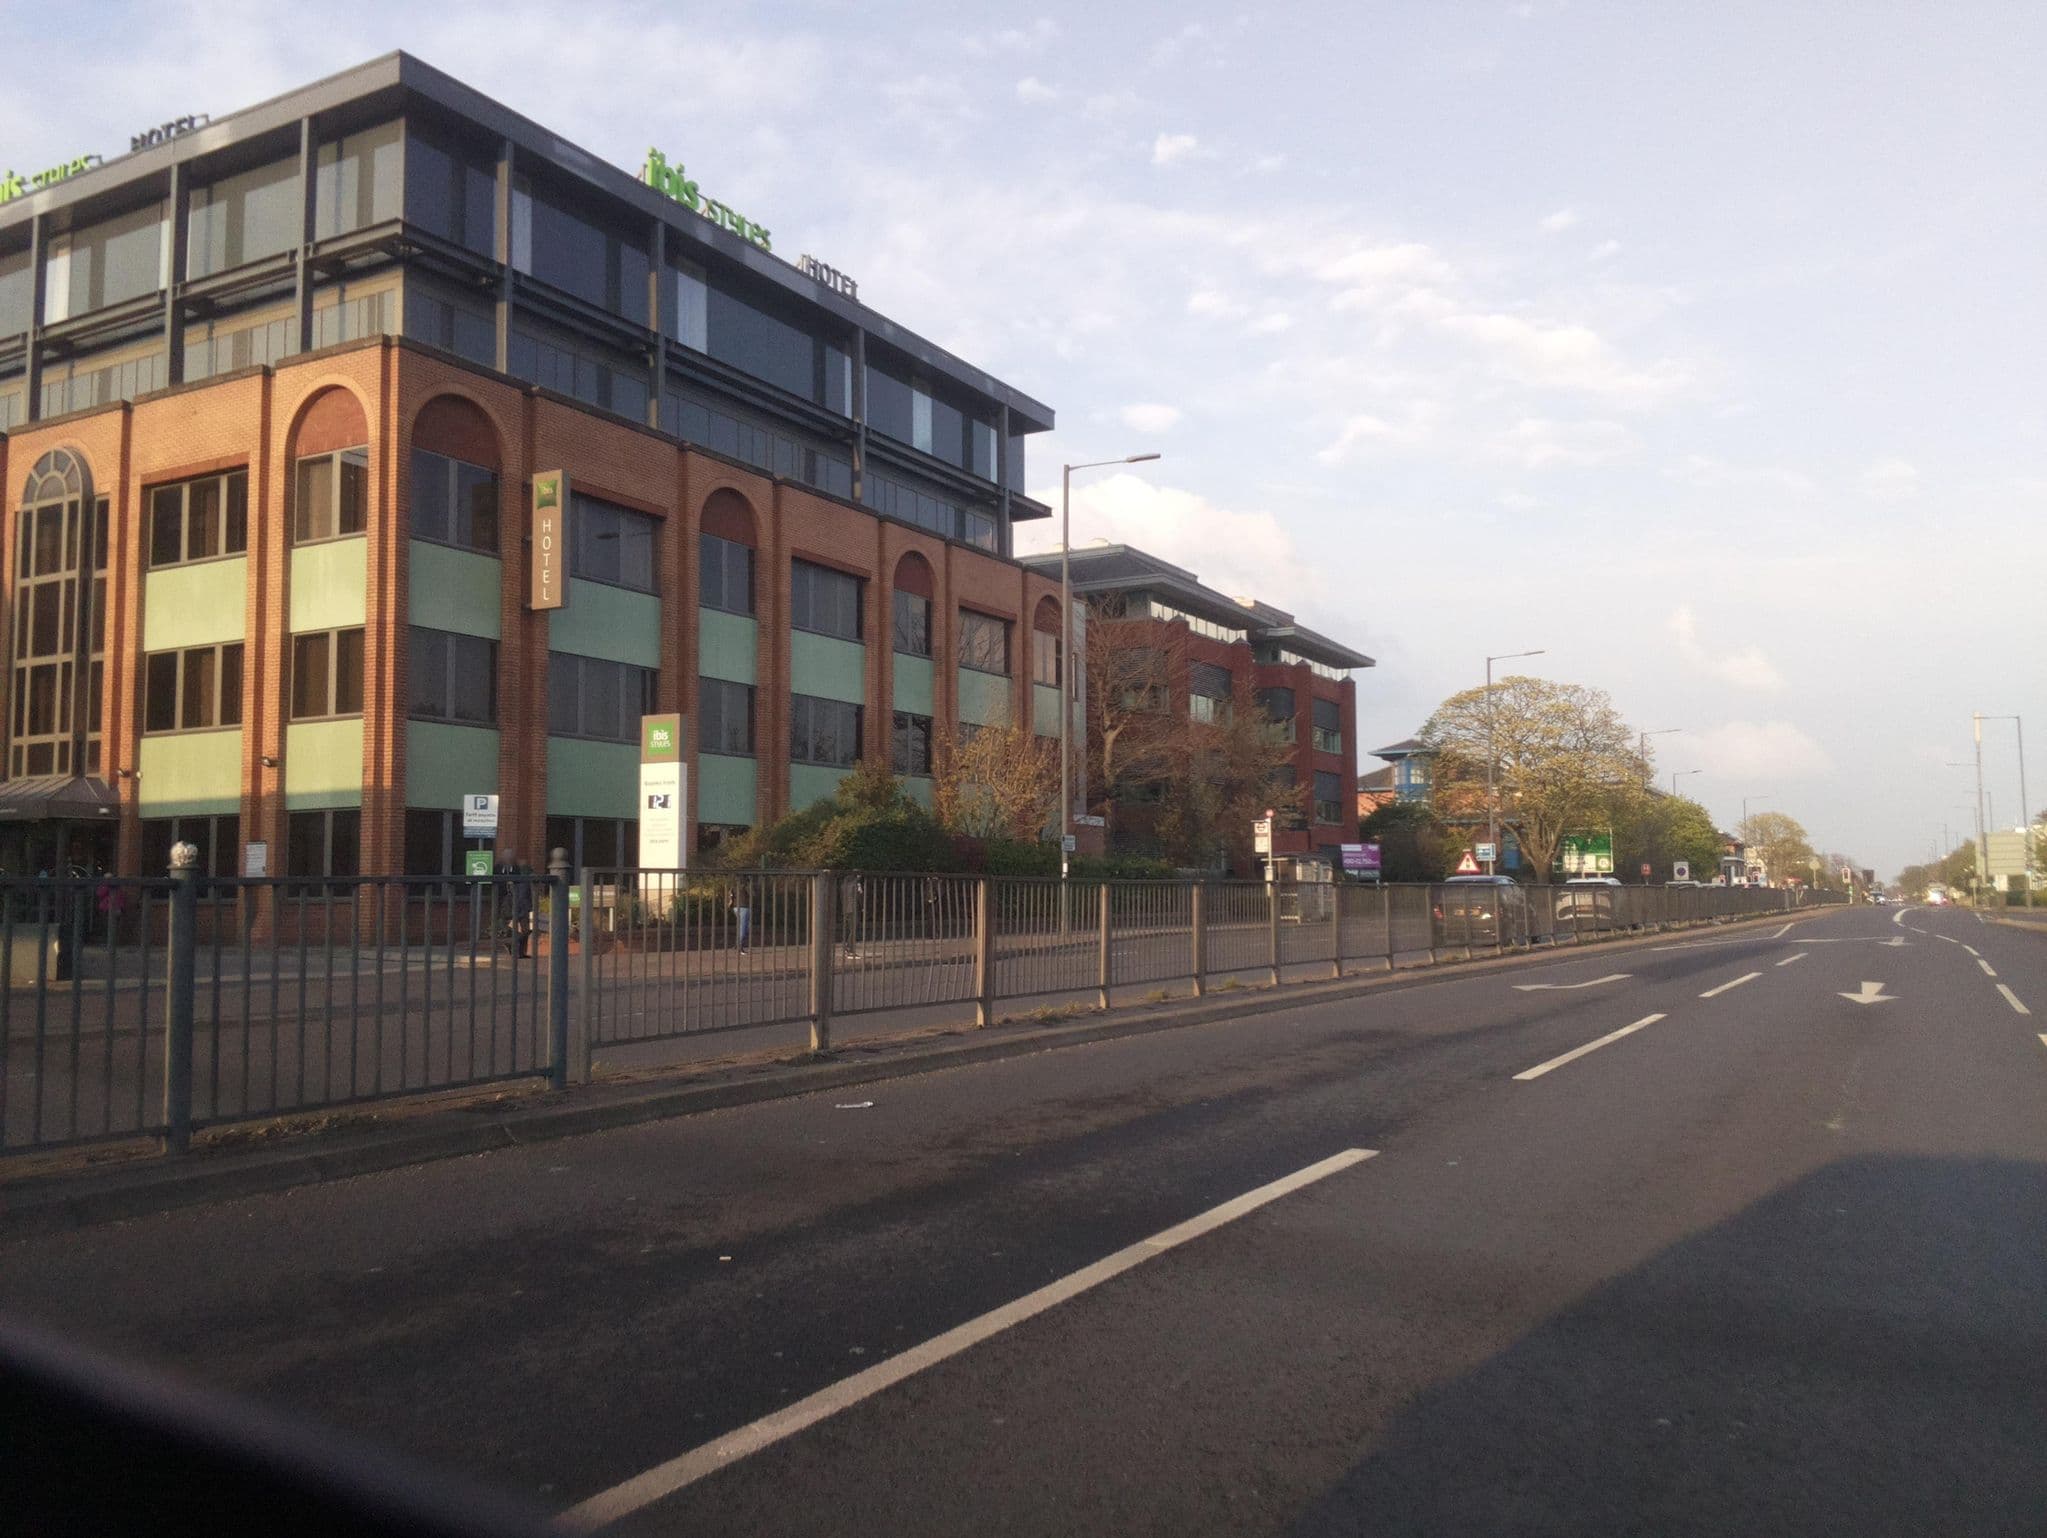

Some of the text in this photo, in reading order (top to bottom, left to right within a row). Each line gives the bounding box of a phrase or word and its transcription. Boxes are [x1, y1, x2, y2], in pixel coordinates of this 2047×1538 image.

[647, 147, 699, 210] ibis
[804, 255, 858, 300] HOTEL
[542, 519, 551, 600] HOTEL
[653, 729, 669, 741] ibis
[476, 798, 487, 809] P
